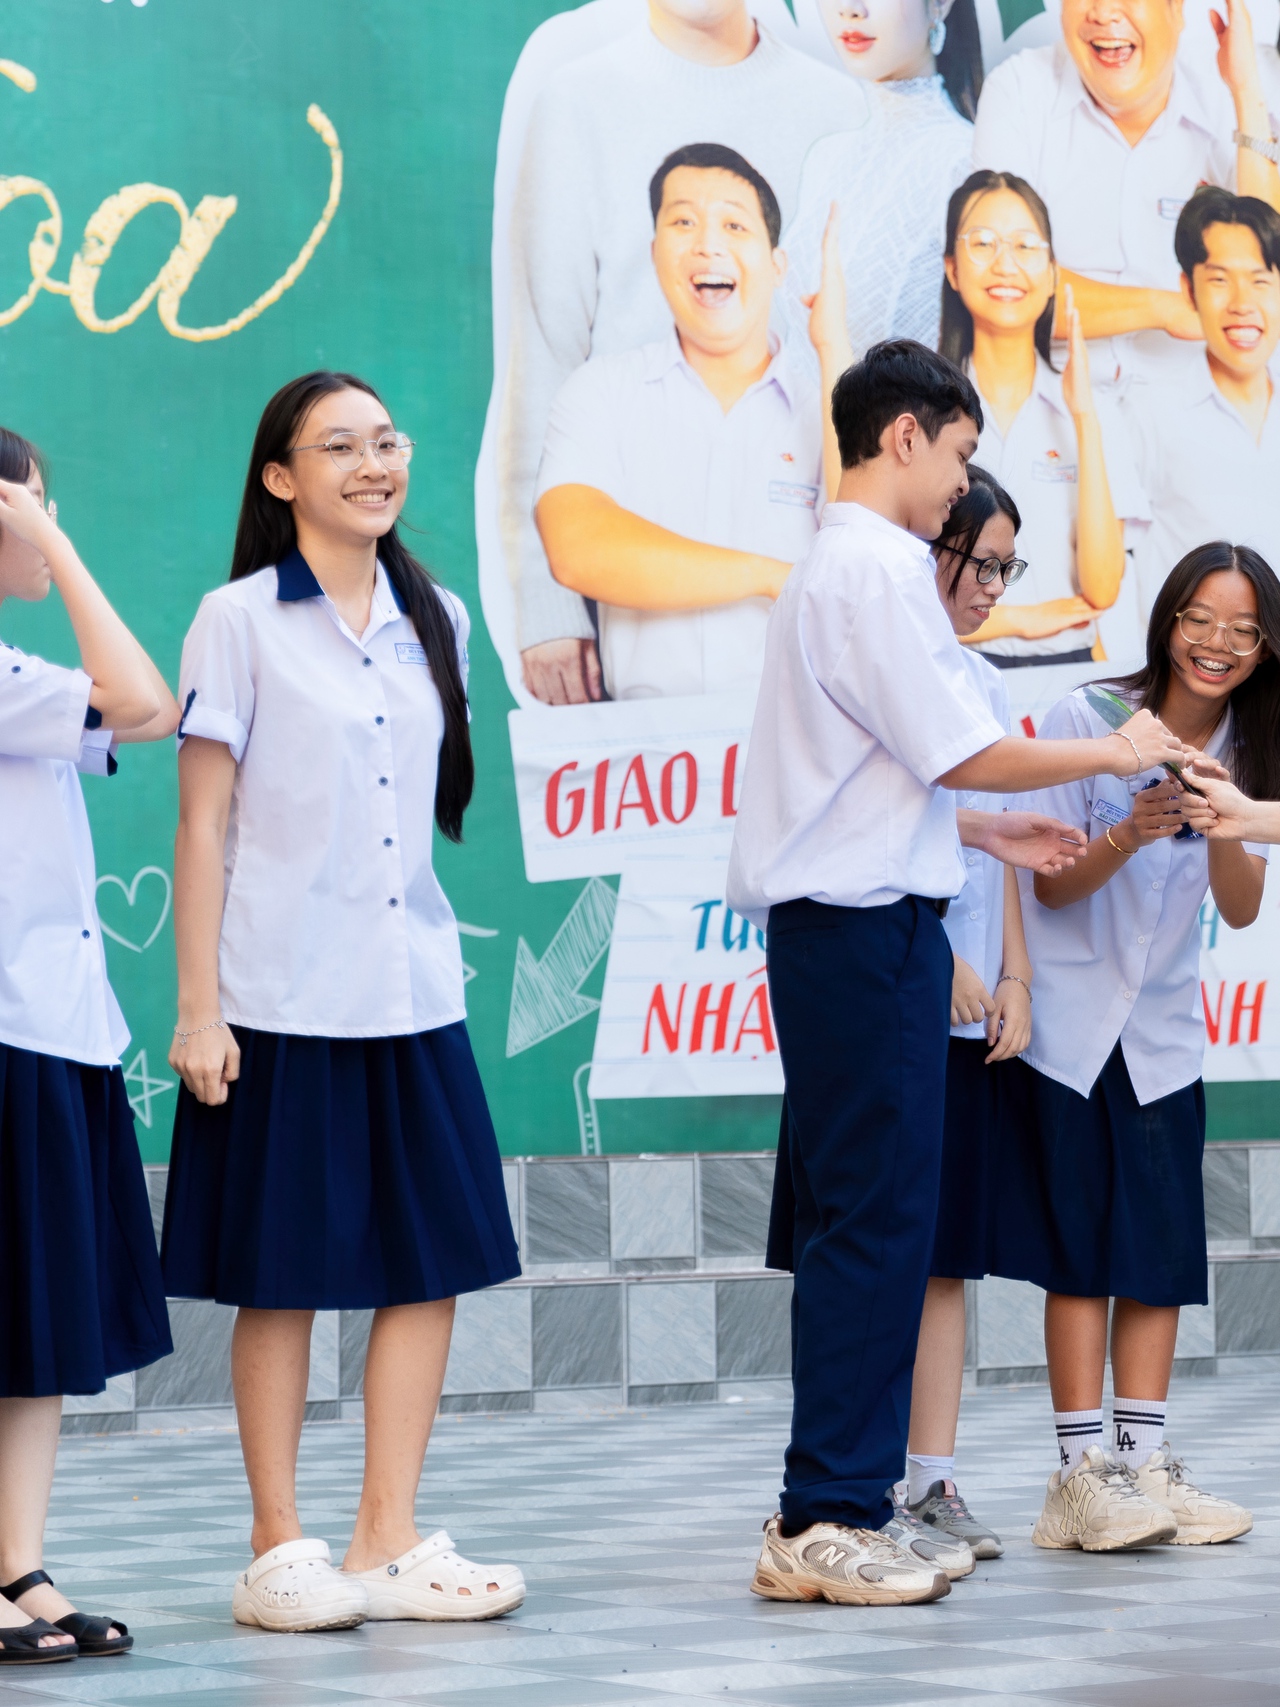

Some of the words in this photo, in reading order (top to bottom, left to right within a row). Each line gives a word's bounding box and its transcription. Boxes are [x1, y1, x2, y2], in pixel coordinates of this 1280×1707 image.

[545, 751, 698, 839] GIAO
[642, 966, 776, 1062] NHẬ
[1116, 1424, 1136, 1451] LA
